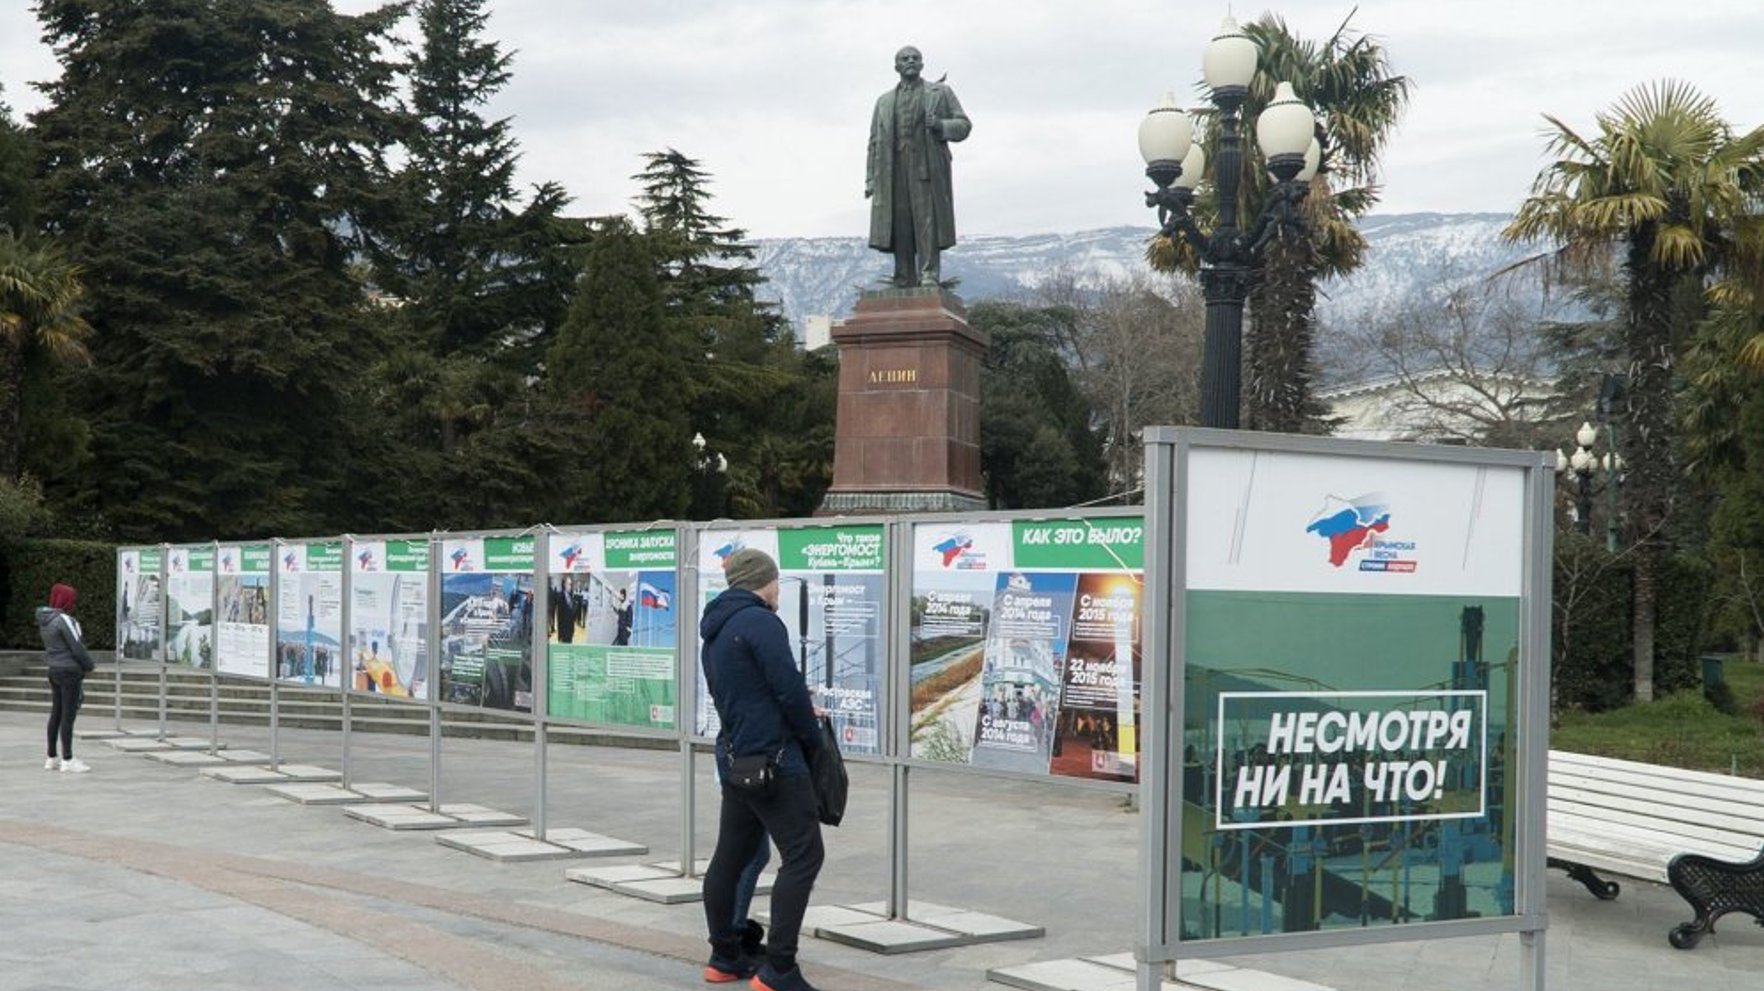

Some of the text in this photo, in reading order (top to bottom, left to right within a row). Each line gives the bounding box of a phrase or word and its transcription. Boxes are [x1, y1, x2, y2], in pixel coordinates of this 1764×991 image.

[868, 369, 916, 383] ЛЕНИН
[1022, 526, 1143, 545] КАК ЭТО БЫЛО?
[1003, 595, 1013, 606] С
[1080, 594, 1090, 607] С
[1000, 607, 1051, 621] 2014 года
[1078, 608, 1106, 621] 2015
[1070, 658, 1084, 672] 22
[1071, 671, 1098, 684] 2015
[839, 698, 863, 710] АЭС
[982, 715, 991, 727] С
[1267, 709, 1473, 755] НЕСМОТРЯ
[1233, 759, 1448, 808] НИ НА ЧТО!
